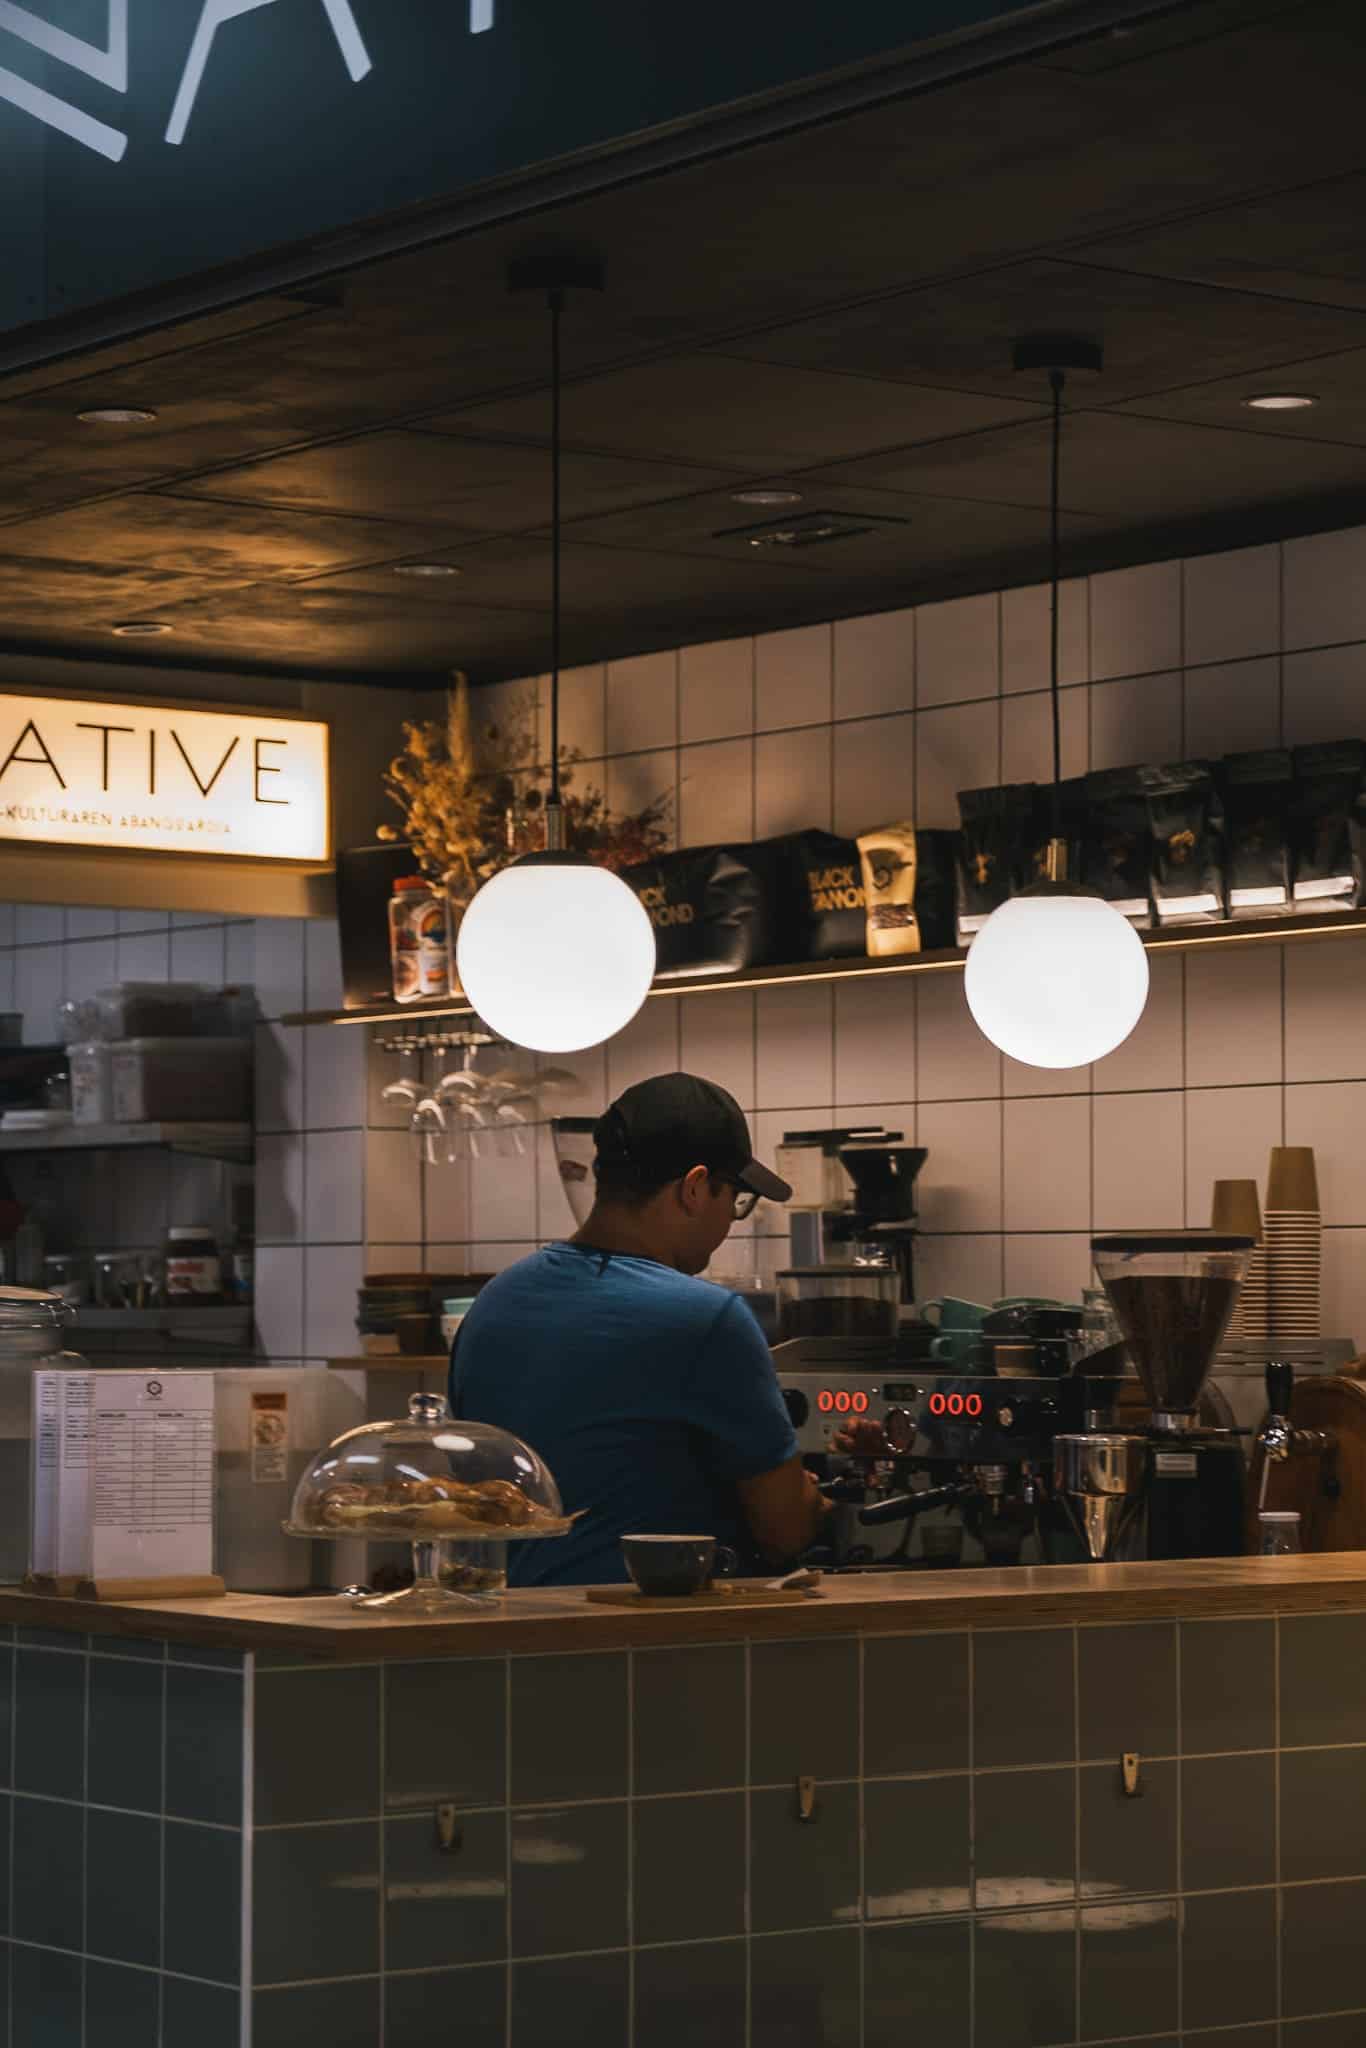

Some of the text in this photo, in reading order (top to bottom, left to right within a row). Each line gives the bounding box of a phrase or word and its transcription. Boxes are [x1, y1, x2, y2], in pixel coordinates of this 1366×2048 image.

[0, 719, 289, 805] ATIVE
[817, 1391, 869, 1413] 000
[928, 1393, 983, 1416] 000
